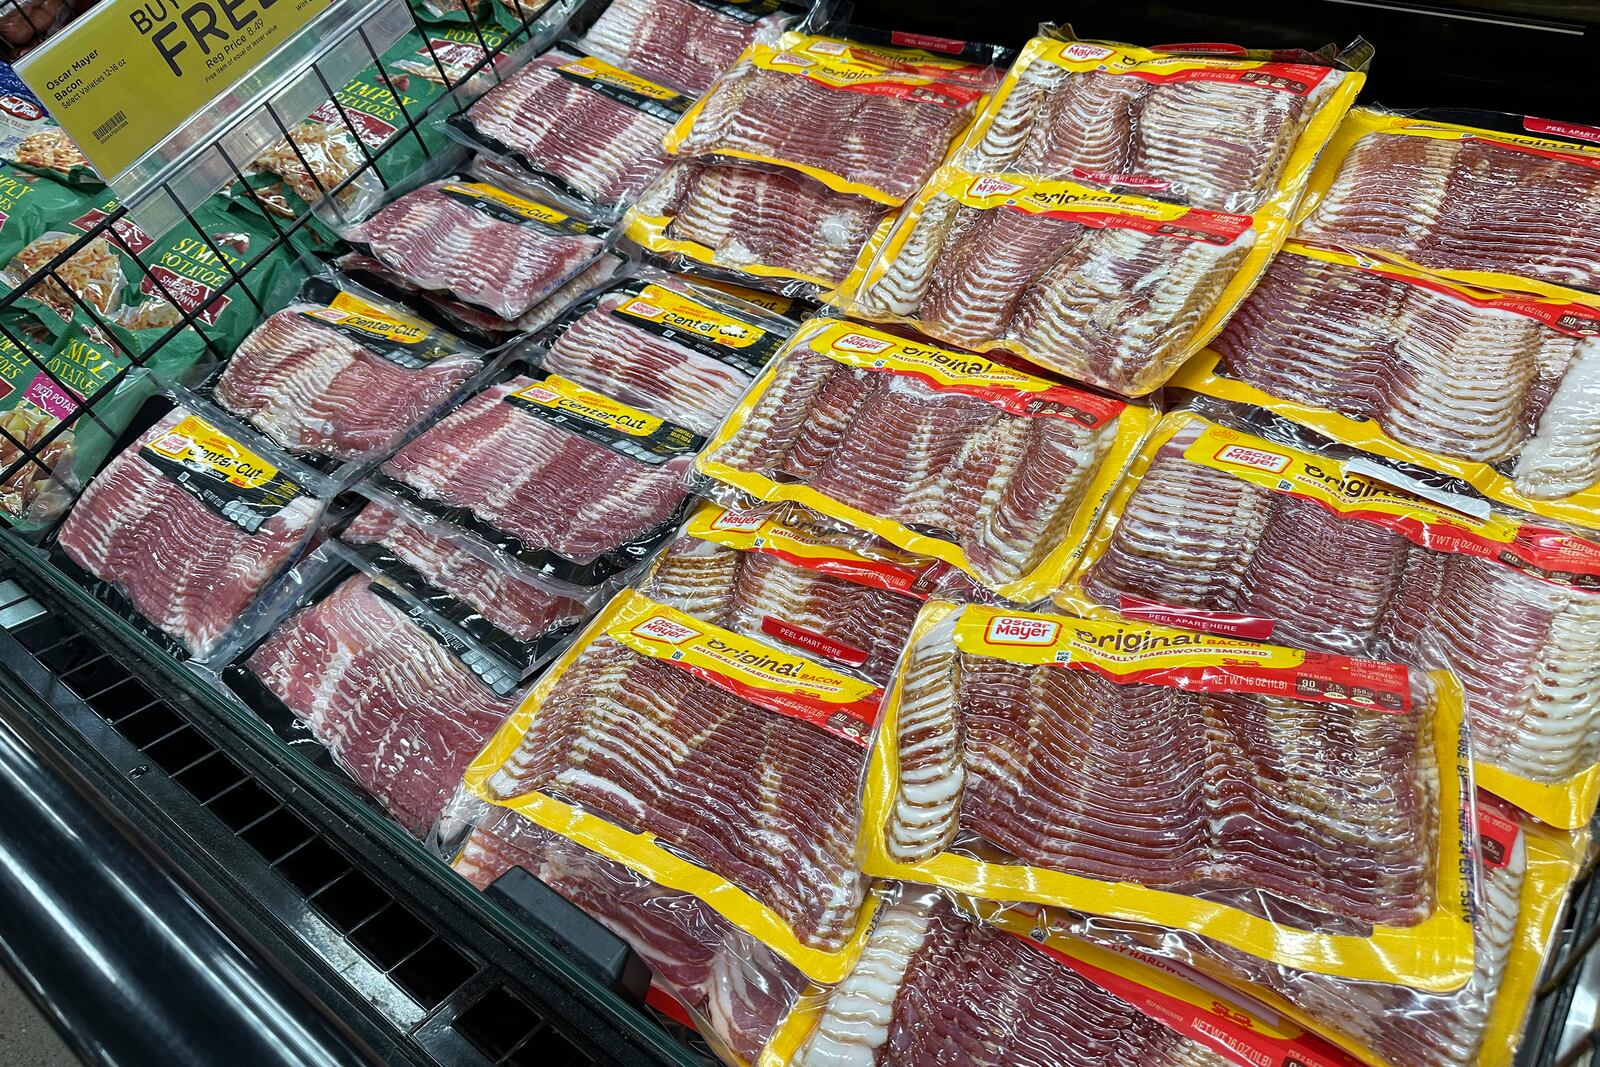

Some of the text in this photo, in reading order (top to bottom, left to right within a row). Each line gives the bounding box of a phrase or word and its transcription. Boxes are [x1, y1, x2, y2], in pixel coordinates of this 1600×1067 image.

[205, 18, 265, 69] Reg Price 8.49
[204, 71, 217, 83] Free
[215, 63, 228, 75] item
[227, 59, 234, 67] of
[232, 48, 247, 64] equal
[250, 34, 265, 49] lesser
[263, 24, 279, 38] value
[46, 69, 72, 91] Oscar
[71, 49, 99, 72] Mayer
[54, 78, 83, 101] Bacon
[61, 58, 127, 109] Select Varieties 12-16 oz
[639, 82, 666, 97] Cut
[332, 92, 400, 121] OTATOES
[1546, 125, 1597, 140] PEEL APART
[526, 208, 554, 221] Cut
[159, 251, 228, 289] POTATOE
[346, 316, 422, 337] Center Cut
[662, 311, 719, 333] Center
[1563, 316, 1577, 325] 90
[843, 338, 882, 351] Mayer
[891, 353, 940, 371] NATURALLY
[989, 373, 1029, 382] SMOKED
[901, 346, 993, 375] Original
[558, 398, 648, 431] Center Cut
[1225, 452, 1280, 469] Mayer
[236, 462, 264, 480] Cut
[1296, 474, 1483, 527] NATURALLY HARDWOOD SMOKED
[720, 515, 760, 527] Mayer
[770, 528, 821, 545] NATURALLY
[1435, 535, 1451, 547] WT
[1451, 537, 1460, 549] 16
[1461, 540, 1472, 551] OZ
[1472, 543, 1492, 556] (1LB)
[1504, 553, 1519, 563] 90
[892, 575, 907, 587] (1LB)
[916, 579, 929, 589] 90
[643, 621, 687, 639] Mayer
[653, 618, 692, 635] Oscar
[1001, 617, 1051, 629] Oscar
[1148, 613, 1238, 632] PEEL APART HERE
[995, 624, 1051, 640] Mayer
[1074, 628, 1203, 653] Original
[779, 628, 841, 657] PEEL APART HERE
[1072, 641, 1269, 662] NATURALLY HARDWOOD SMOKED
[1206, 639, 1262, 648] BACON
[705, 638, 805, 678] Original
[692, 645, 838, 693] NATURALLY HARDWOOD SMOKED
[799, 673, 842, 686] BACON
[1211, 674, 1229, 686] NET
[1229, 674, 1245, 686] WT
[1245, 676, 1254, 687] 16
[1255, 677, 1268, 688] OZ
[1268, 679, 1289, 691] (1LB)
[1301, 679, 1316, 688] 90
[834, 713, 847, 722] 90
[1492, 818, 1513, 833] WOOD
[1191, 1017, 1273, 1067] NET WT 16 OZ (1LB)
